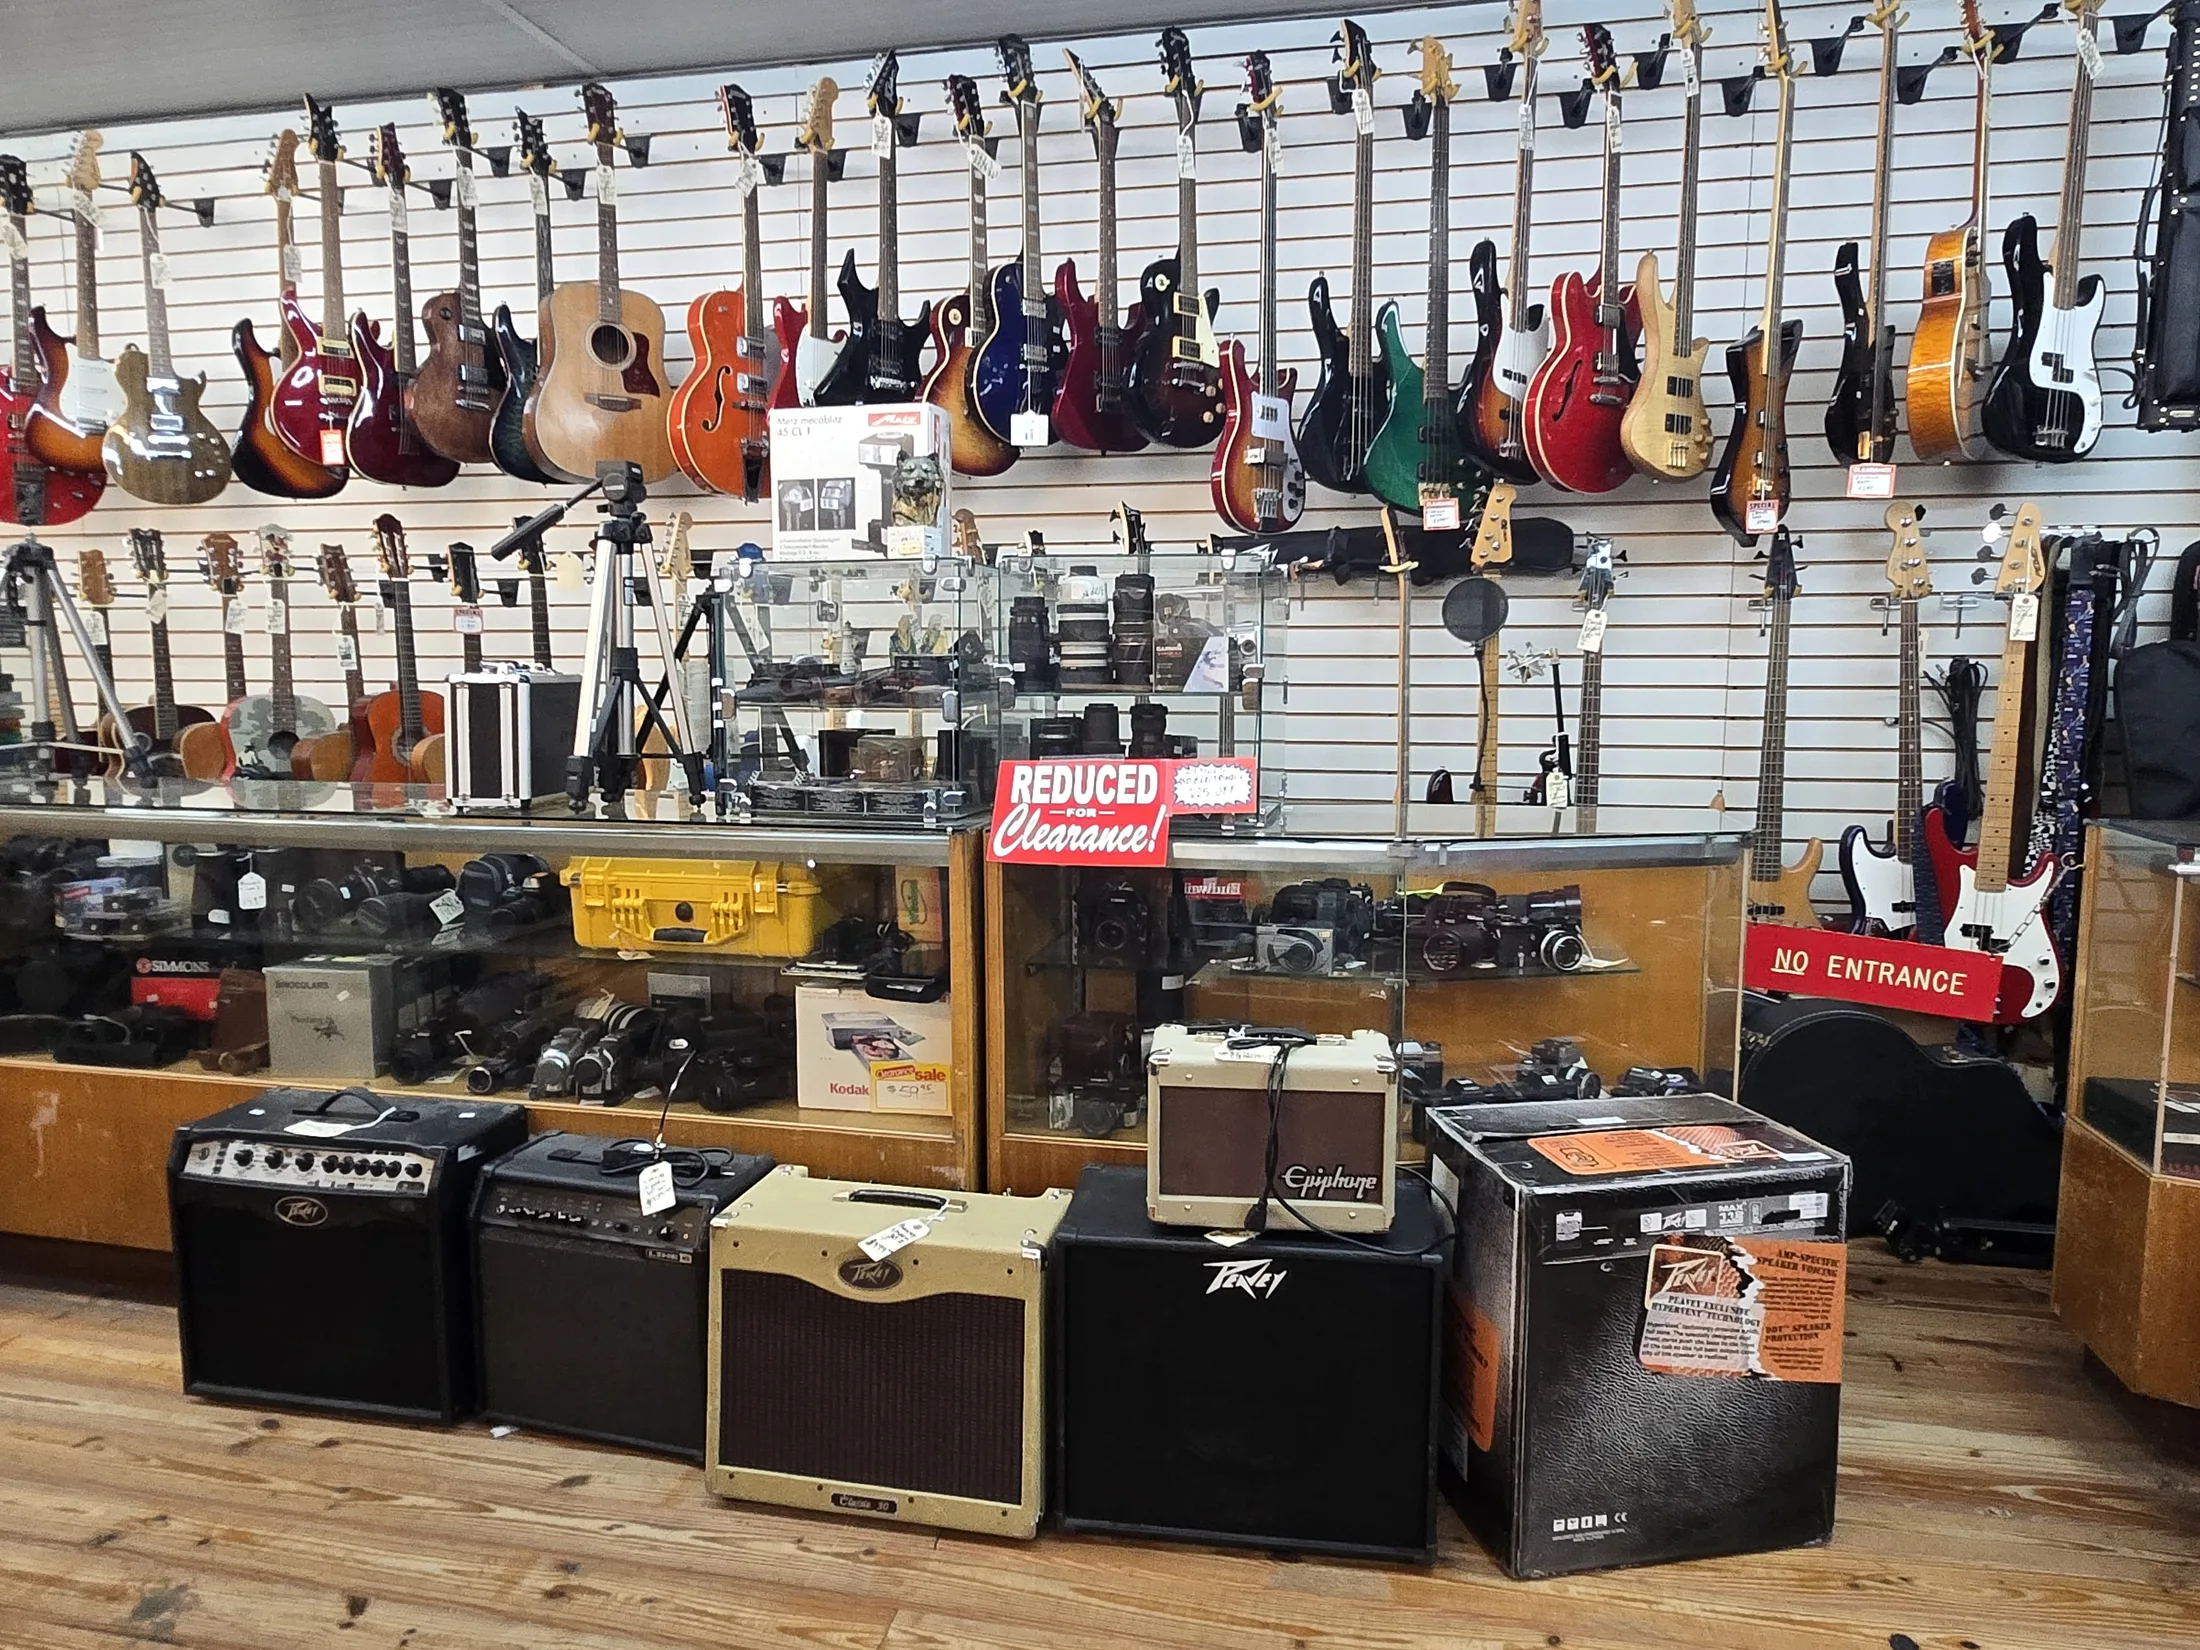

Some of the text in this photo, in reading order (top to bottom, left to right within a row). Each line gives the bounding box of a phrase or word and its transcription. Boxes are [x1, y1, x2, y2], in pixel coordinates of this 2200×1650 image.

[1010, 764, 1159, 805] REDUCED
[1066, 808, 1097, 818] FOR
[993, 803, 1167, 857] Clearance!
[151, 960, 210, 973] SIMMONS
[1774, 948, 1968, 996] NO ENTRANCE
[915, 1068, 946, 1081] sale
[829, 1083, 869, 1096] Kodak
[1281, 1165, 1377, 1199] Epiphone
[1756, 1257, 1799, 1271] SPEAKER
[1203, 1259, 1288, 1300] PEAVEY
[1668, 1296, 1751, 1316] PEAVEY EXCLUSIVE
[1707, 1311, 1761, 1328] TECHNOLOGY
[1792, 1322, 1832, 1332] SPEAKER
[1765, 1332, 1819, 1342] PROTECTION
